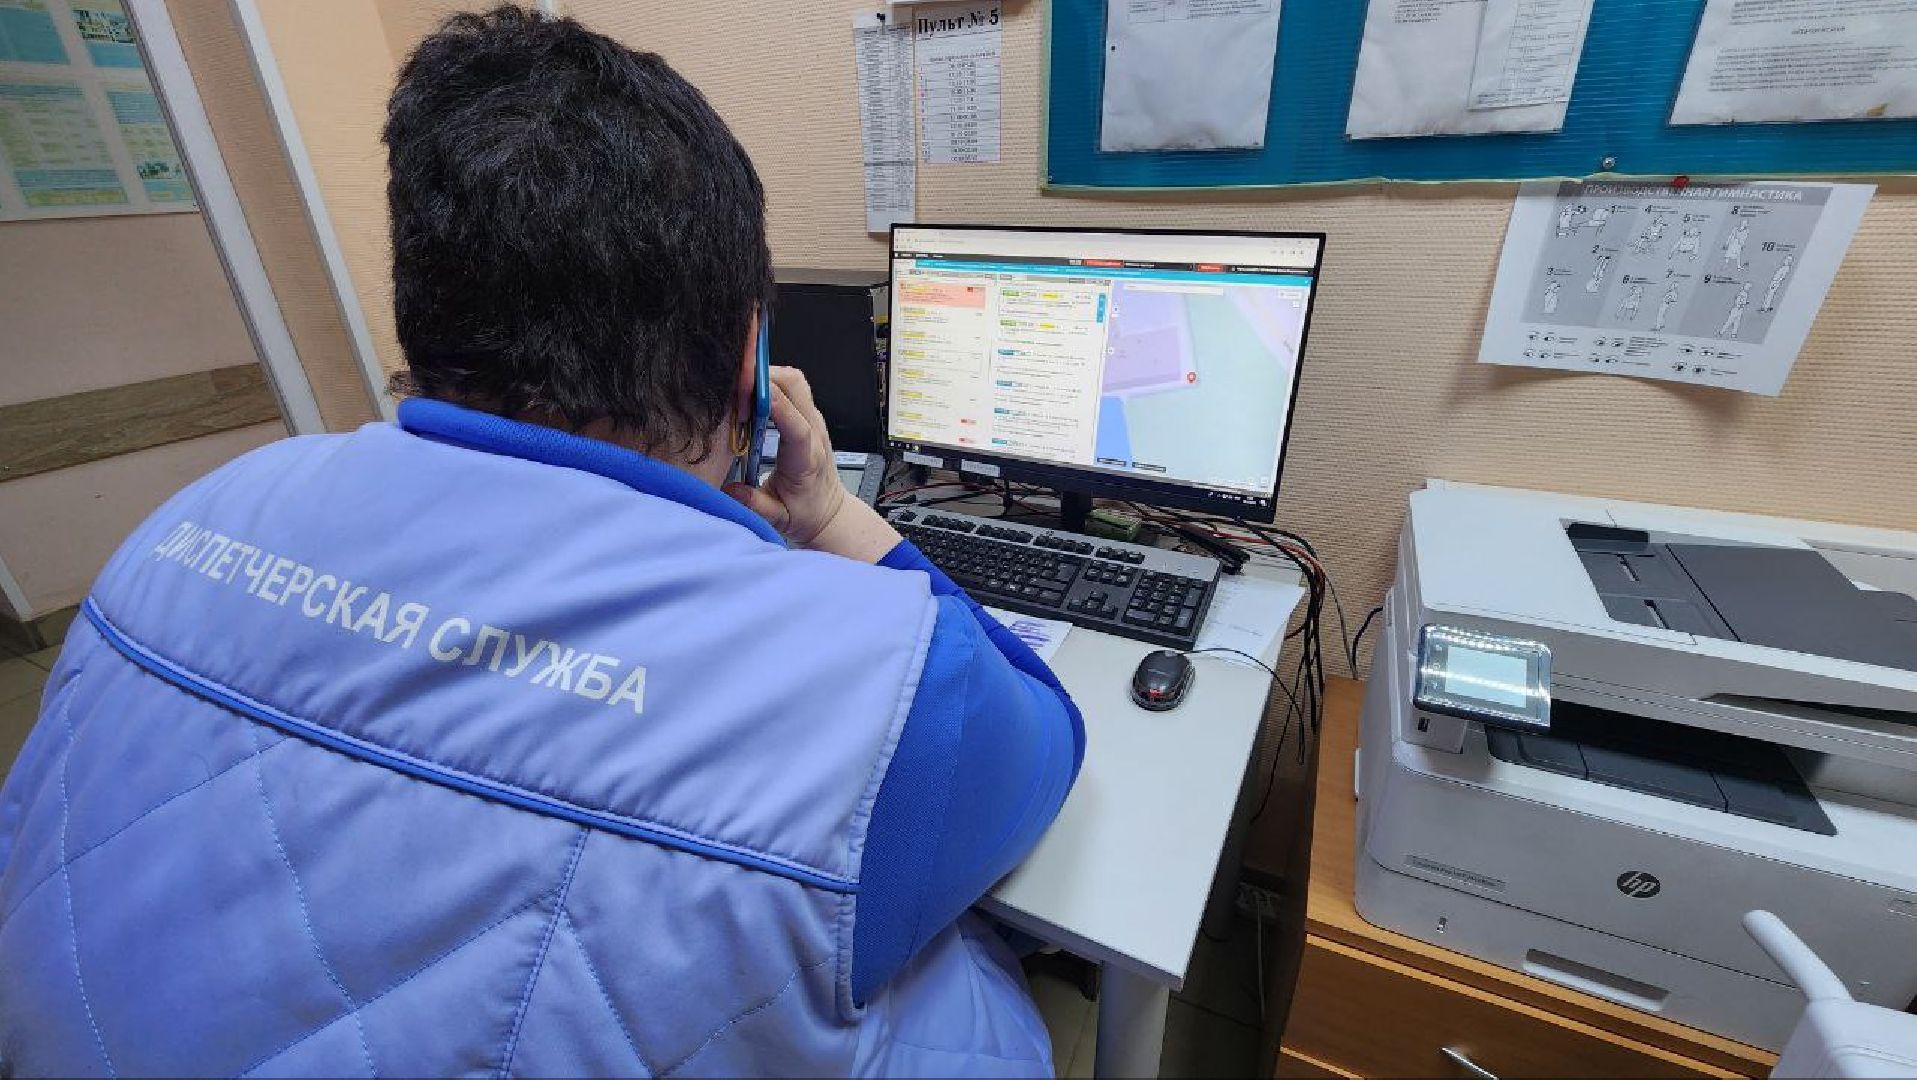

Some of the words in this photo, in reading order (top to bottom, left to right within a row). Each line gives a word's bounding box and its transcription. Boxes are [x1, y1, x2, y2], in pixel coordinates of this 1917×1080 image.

[918, 16, 965, 38] Пульт
[967, 10, 985, 29] №
[989, 8, 999, 26] 5
[1761, 242, 1776, 252] 10
[154, 520, 430, 649] ДИСПЕТЧЕРСКАЯ
[429, 617, 647, 714] СЛУЖБА
[1621, 872, 1657, 897] hp
